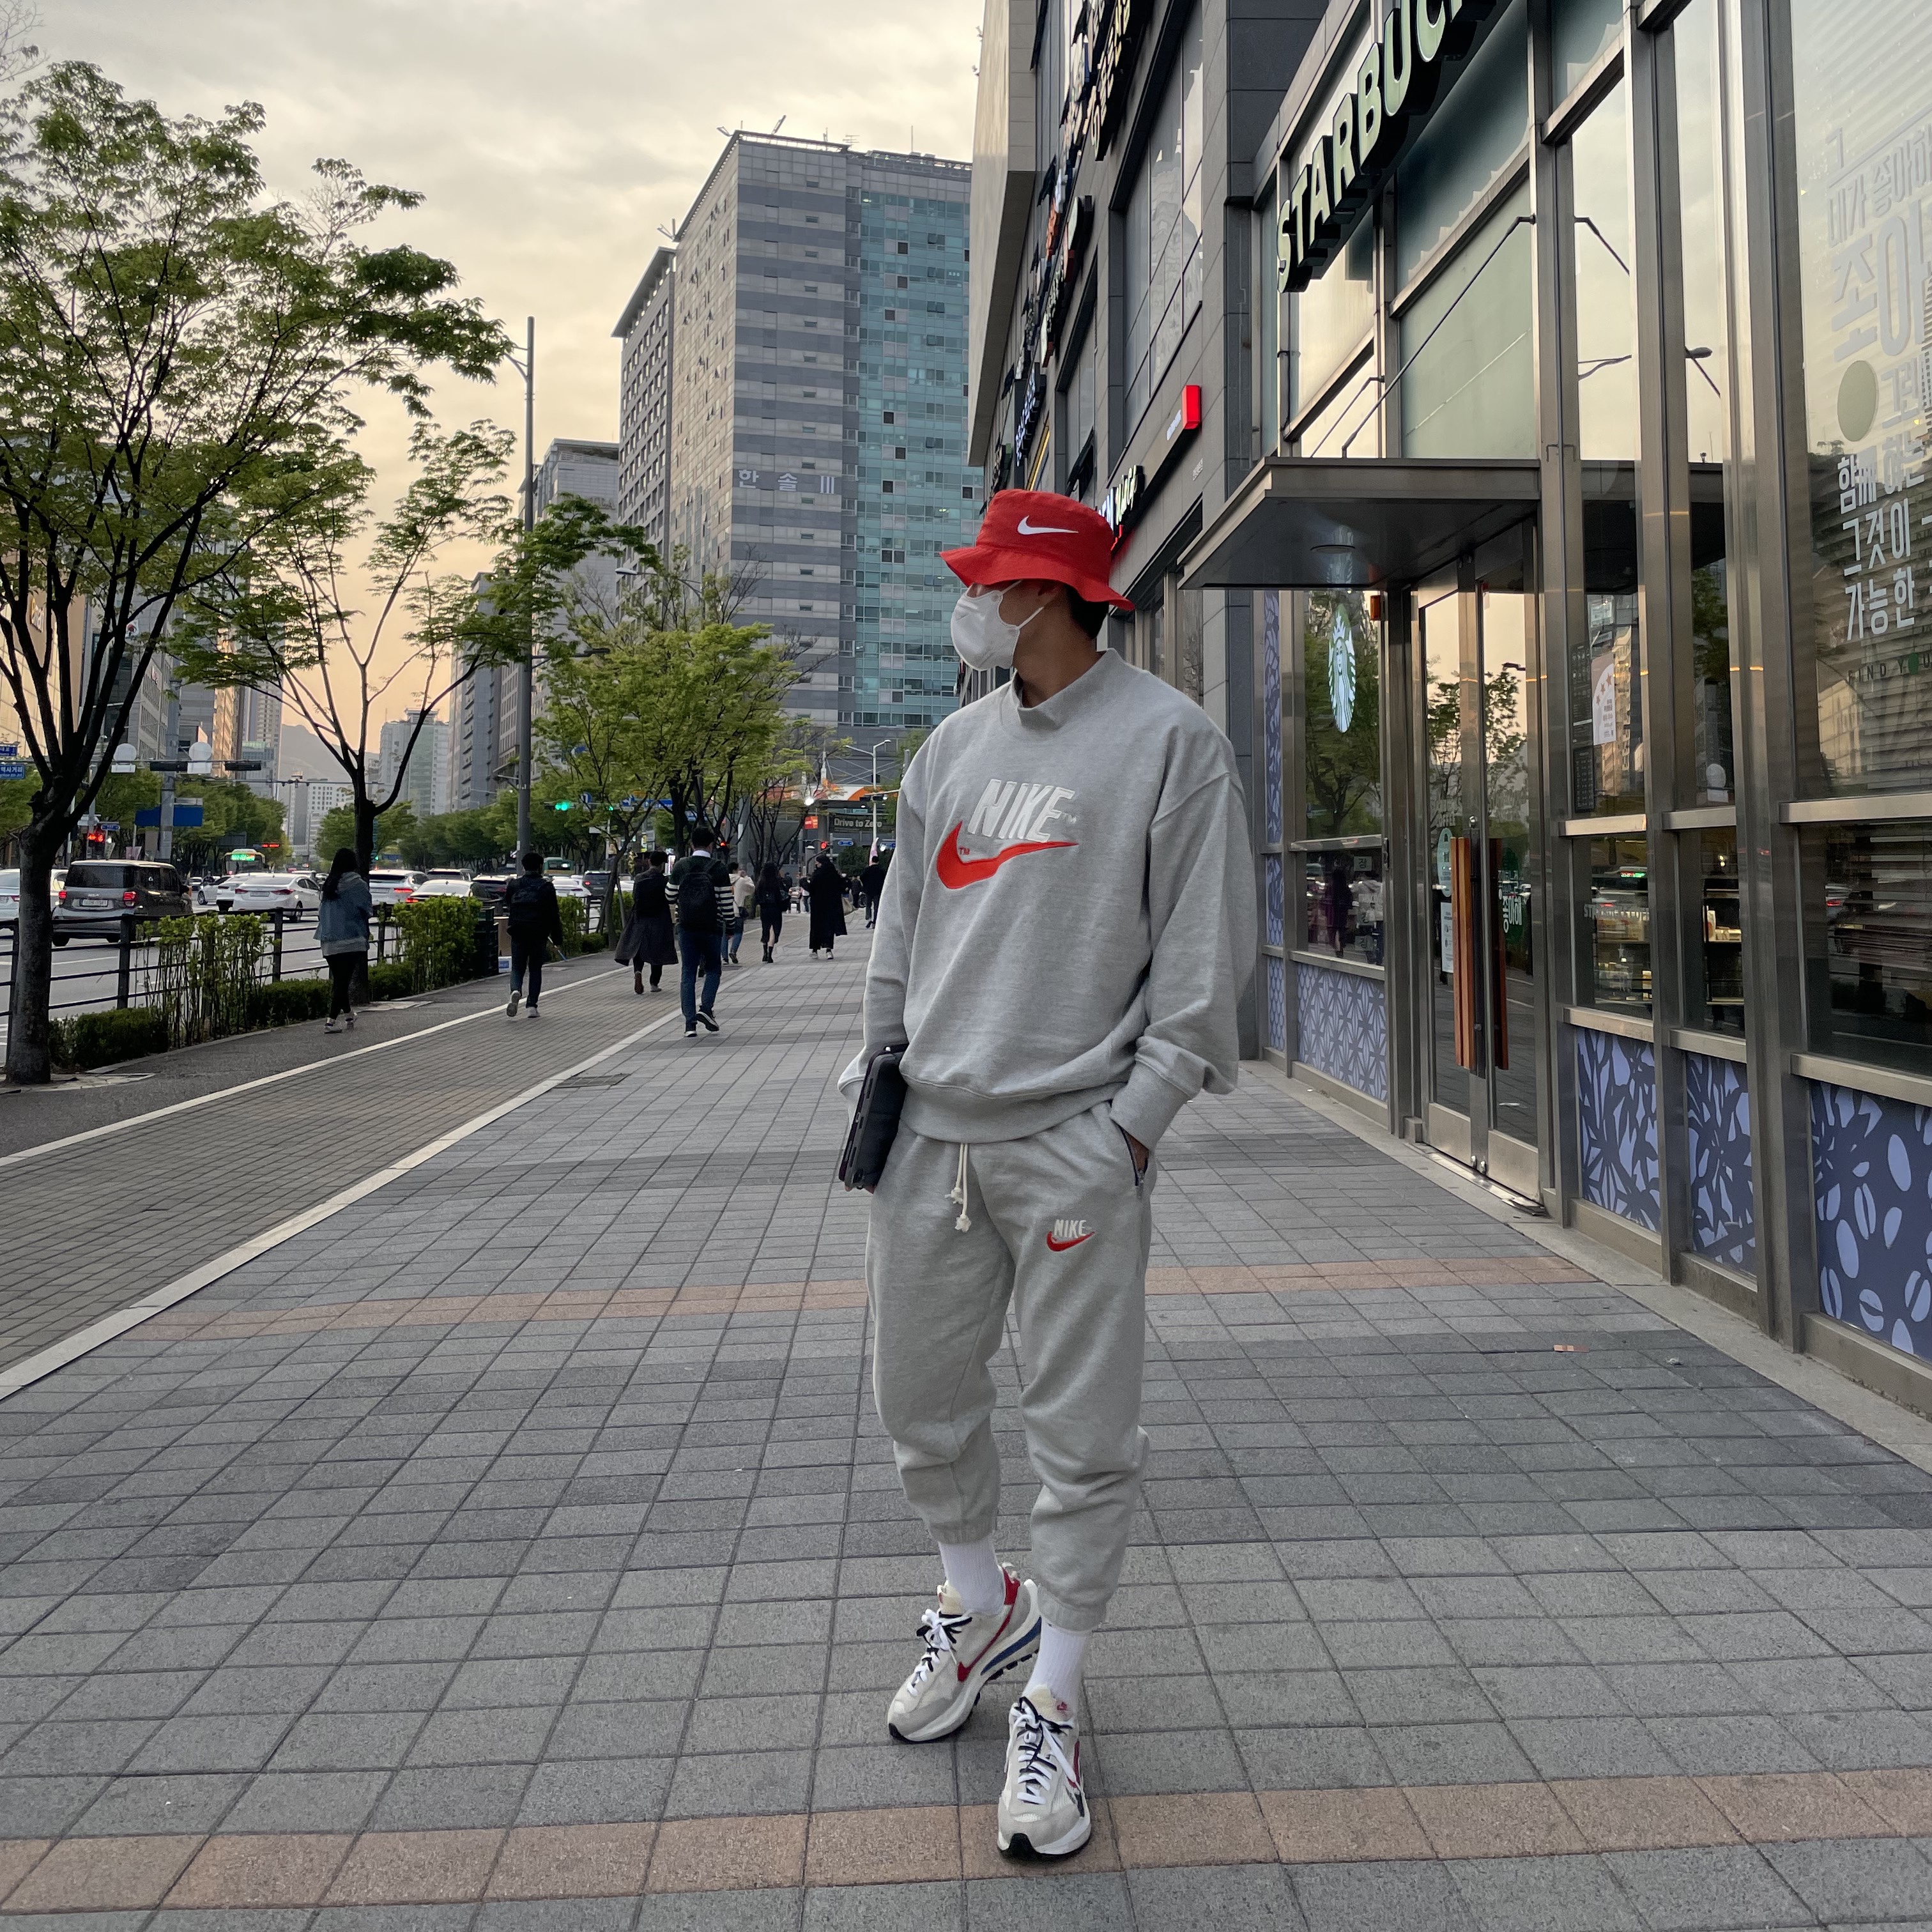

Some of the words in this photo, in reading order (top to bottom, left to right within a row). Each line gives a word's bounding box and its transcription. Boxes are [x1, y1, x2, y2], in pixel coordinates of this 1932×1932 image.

[1843, 498, 1911, 576] 그것이
[1844, 566, 1915, 641] 가능한
[834, 818, 854, 827] Drive
[855, 819, 863, 827] to
[864, 819, 882, 828] Zeo
[967, 779, 1075, 843] NIKE
[1054, 1219, 1087, 1238] NIKE
